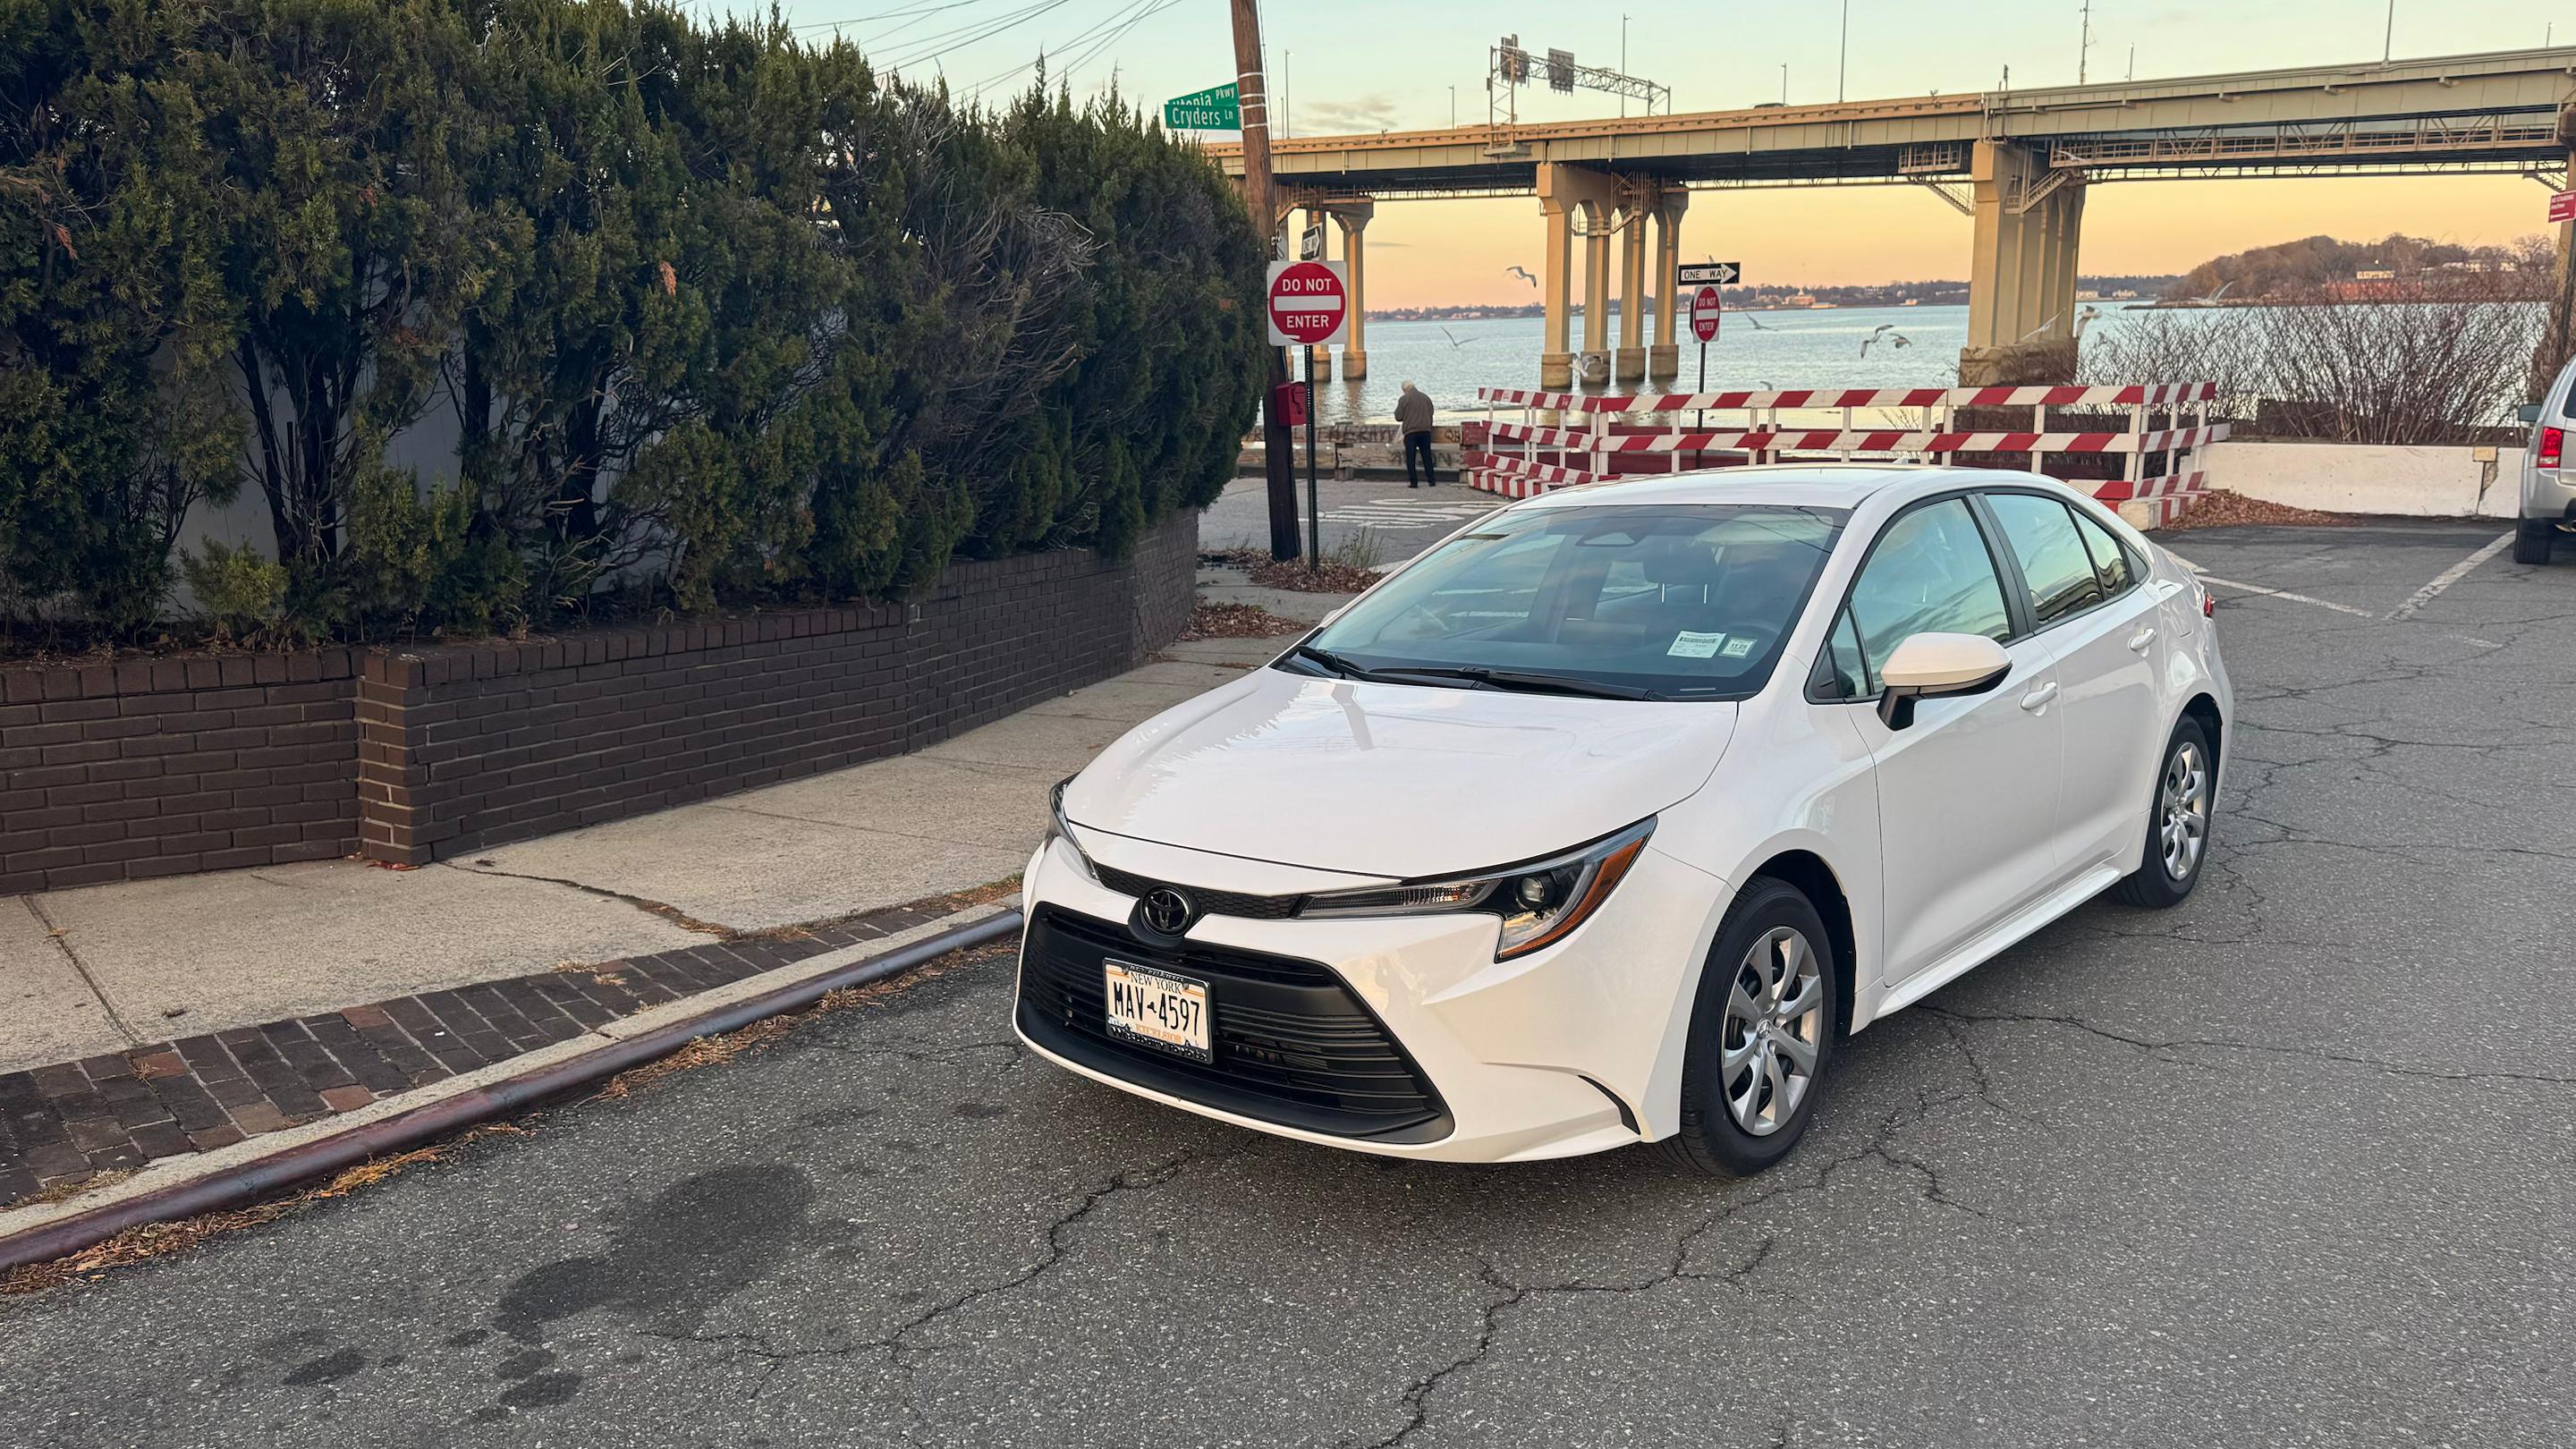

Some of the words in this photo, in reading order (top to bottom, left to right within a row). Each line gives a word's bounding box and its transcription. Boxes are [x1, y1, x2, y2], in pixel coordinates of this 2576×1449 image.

[1173, 93, 1211, 106] pia
[1216, 87, 1234, 99] Pkwy
[1173, 107, 1221, 129] Cryders
[1224, 109, 1233, 120] Ln
[1684, 271, 1700, 279] ONE
[1709, 269, 1728, 278] WAY
[1283, 279, 1301, 292] DO
[1306, 278, 1332, 292] NOT
[1699, 298, 1706, 307] DO
[1707, 297, 1716, 306] NOT
[1286, 315, 1329, 328] ENTER
[1699, 322, 1715, 331] ENTER
[1131, 972, 1153, 986] NEW
[1155, 979, 1182, 995] YORK
[1114, 981, 1144, 1021] MAV
[1158, 993, 1199, 1037] 4597
